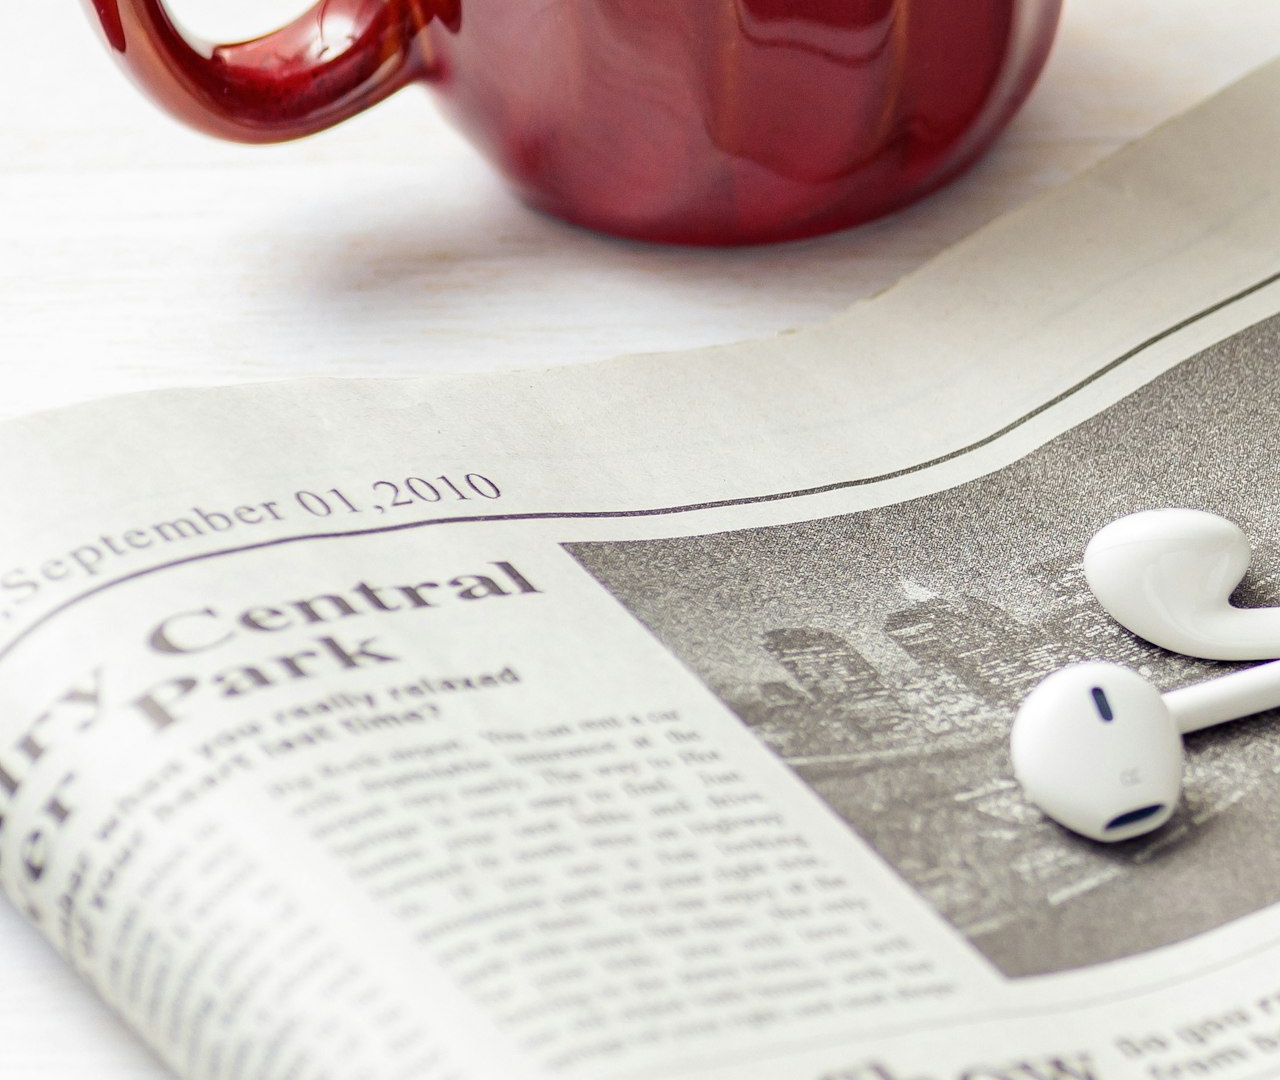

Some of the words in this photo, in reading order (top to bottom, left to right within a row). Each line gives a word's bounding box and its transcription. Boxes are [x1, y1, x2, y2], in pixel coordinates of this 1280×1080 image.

[294, 489, 361, 517] 01
[146, 560, 544, 656] Central
[130, 636, 400, 733] Park
[273, 693, 377, 724] really
[387, 667, 520, 701] relaxed
